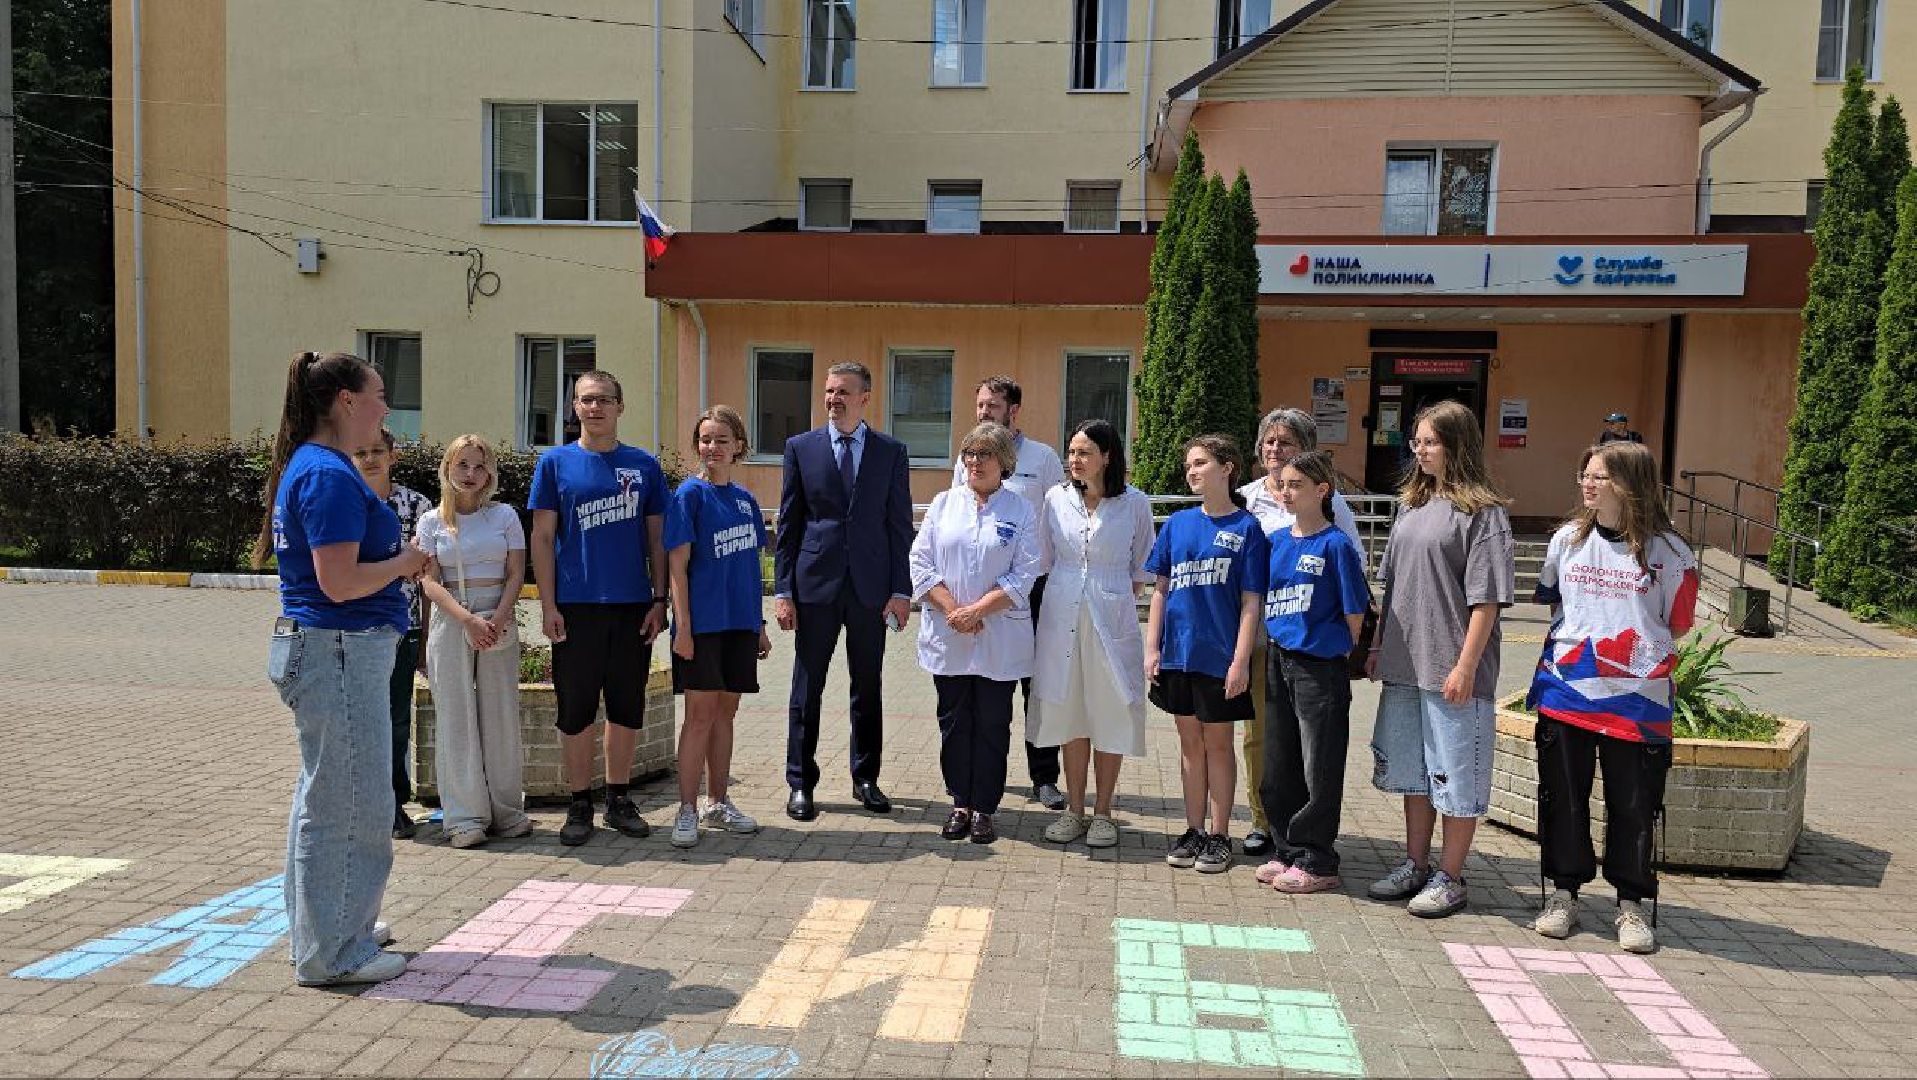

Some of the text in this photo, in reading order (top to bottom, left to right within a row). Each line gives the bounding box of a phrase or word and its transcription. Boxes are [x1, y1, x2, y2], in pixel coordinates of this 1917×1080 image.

[1314, 256, 1362, 270] НАША
[1594, 255, 1664, 273] Служба
[1313, 271, 1436, 286] ПОЛИКЛИНИКА
